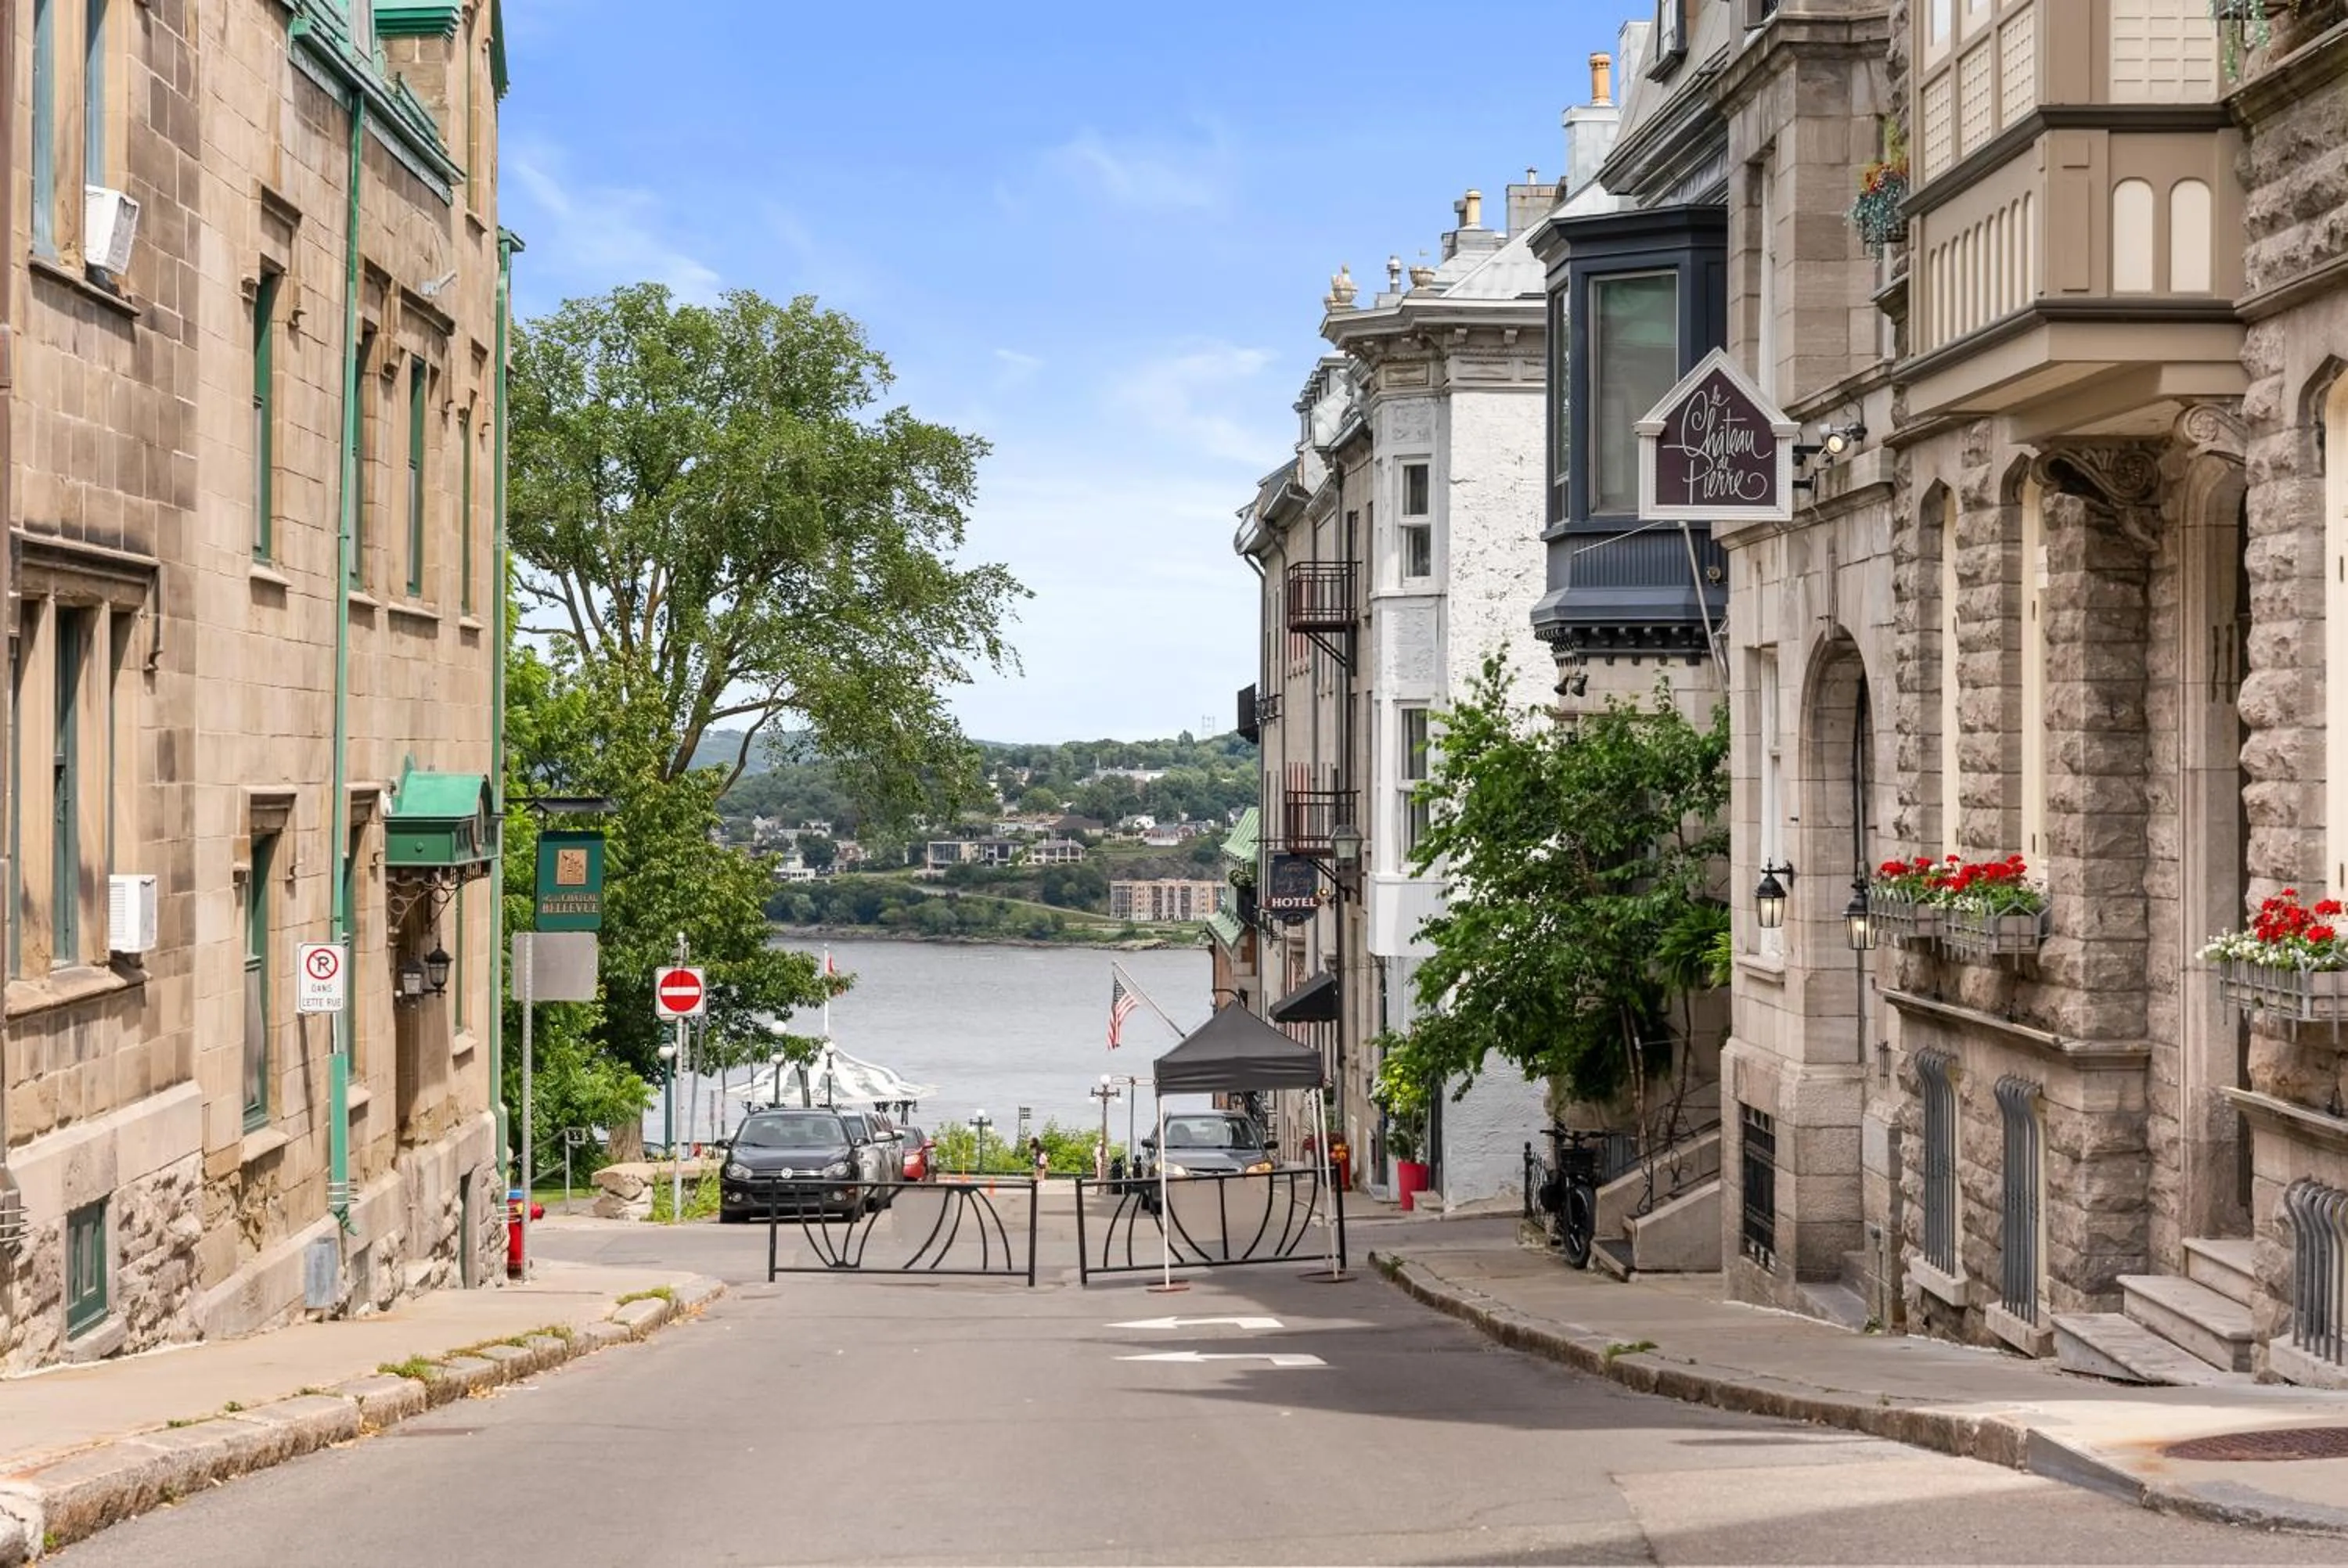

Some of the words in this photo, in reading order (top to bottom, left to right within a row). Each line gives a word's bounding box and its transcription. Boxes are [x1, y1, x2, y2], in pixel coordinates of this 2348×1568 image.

[1681, 390, 1773, 459] Château
[1662, 445, 1768, 505] Pierre
[1272, 897, 1317, 908] HOTEL
[312, 984, 333, 993] DANS
[327, 998, 342, 1007] RUE
